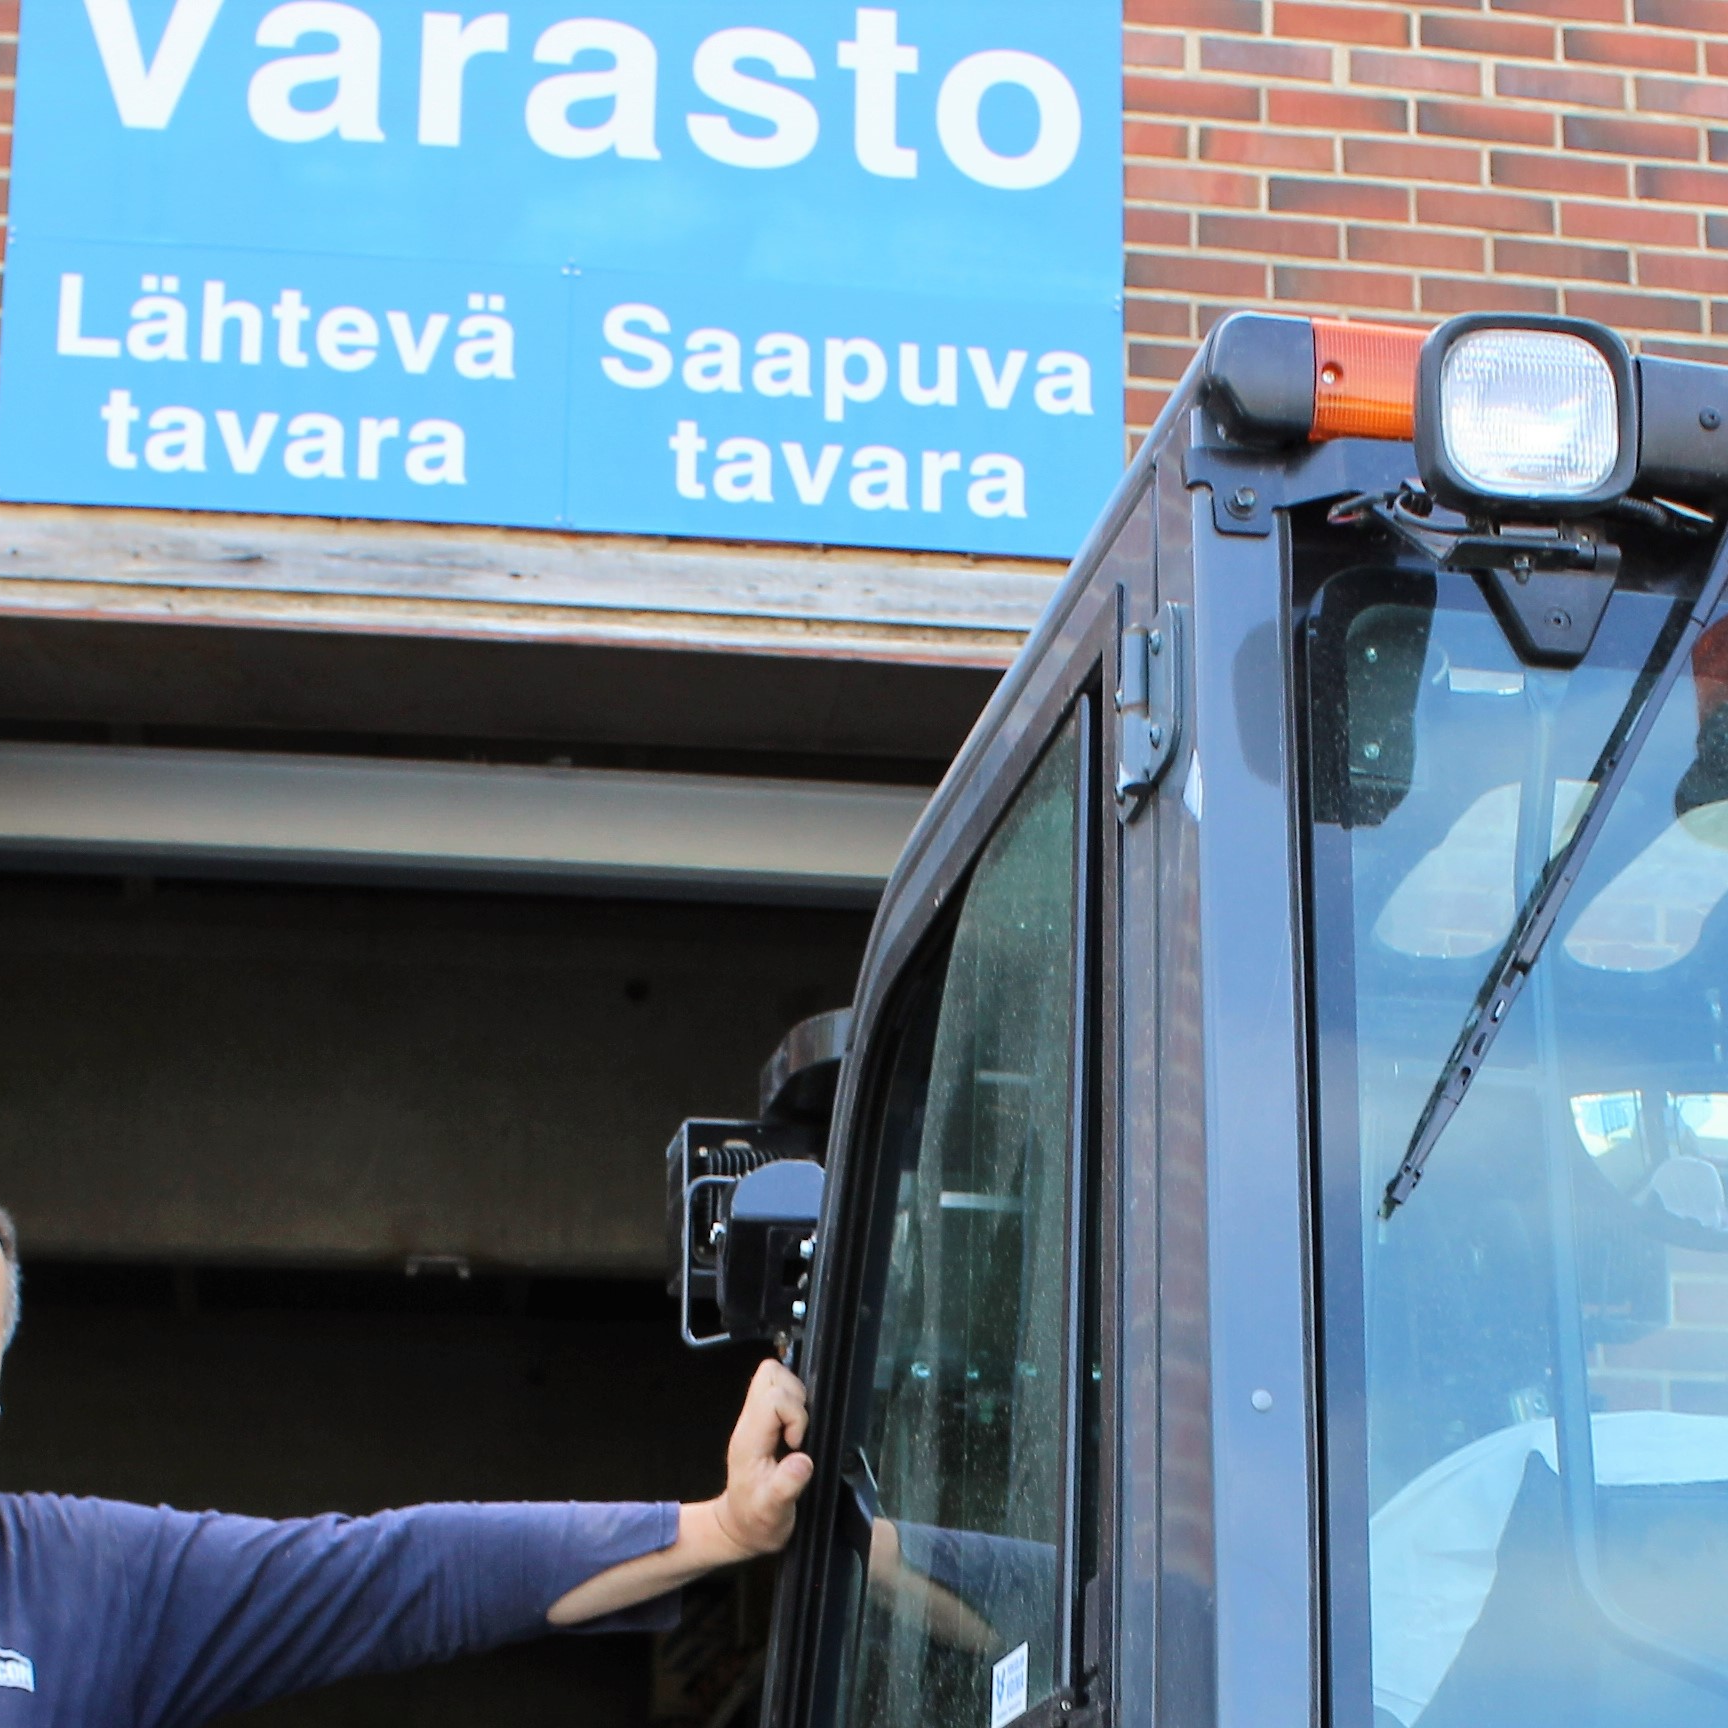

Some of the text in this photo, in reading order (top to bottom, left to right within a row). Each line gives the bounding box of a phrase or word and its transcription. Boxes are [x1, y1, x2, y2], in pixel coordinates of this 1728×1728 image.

[84, 0, 1084, 190] Varasto
[57, 273, 516, 381] Lähtevä
[601, 303, 1095, 423] Saapuva
[100, 389, 468, 486] tavara
[669, 420, 1029, 520] tavara
